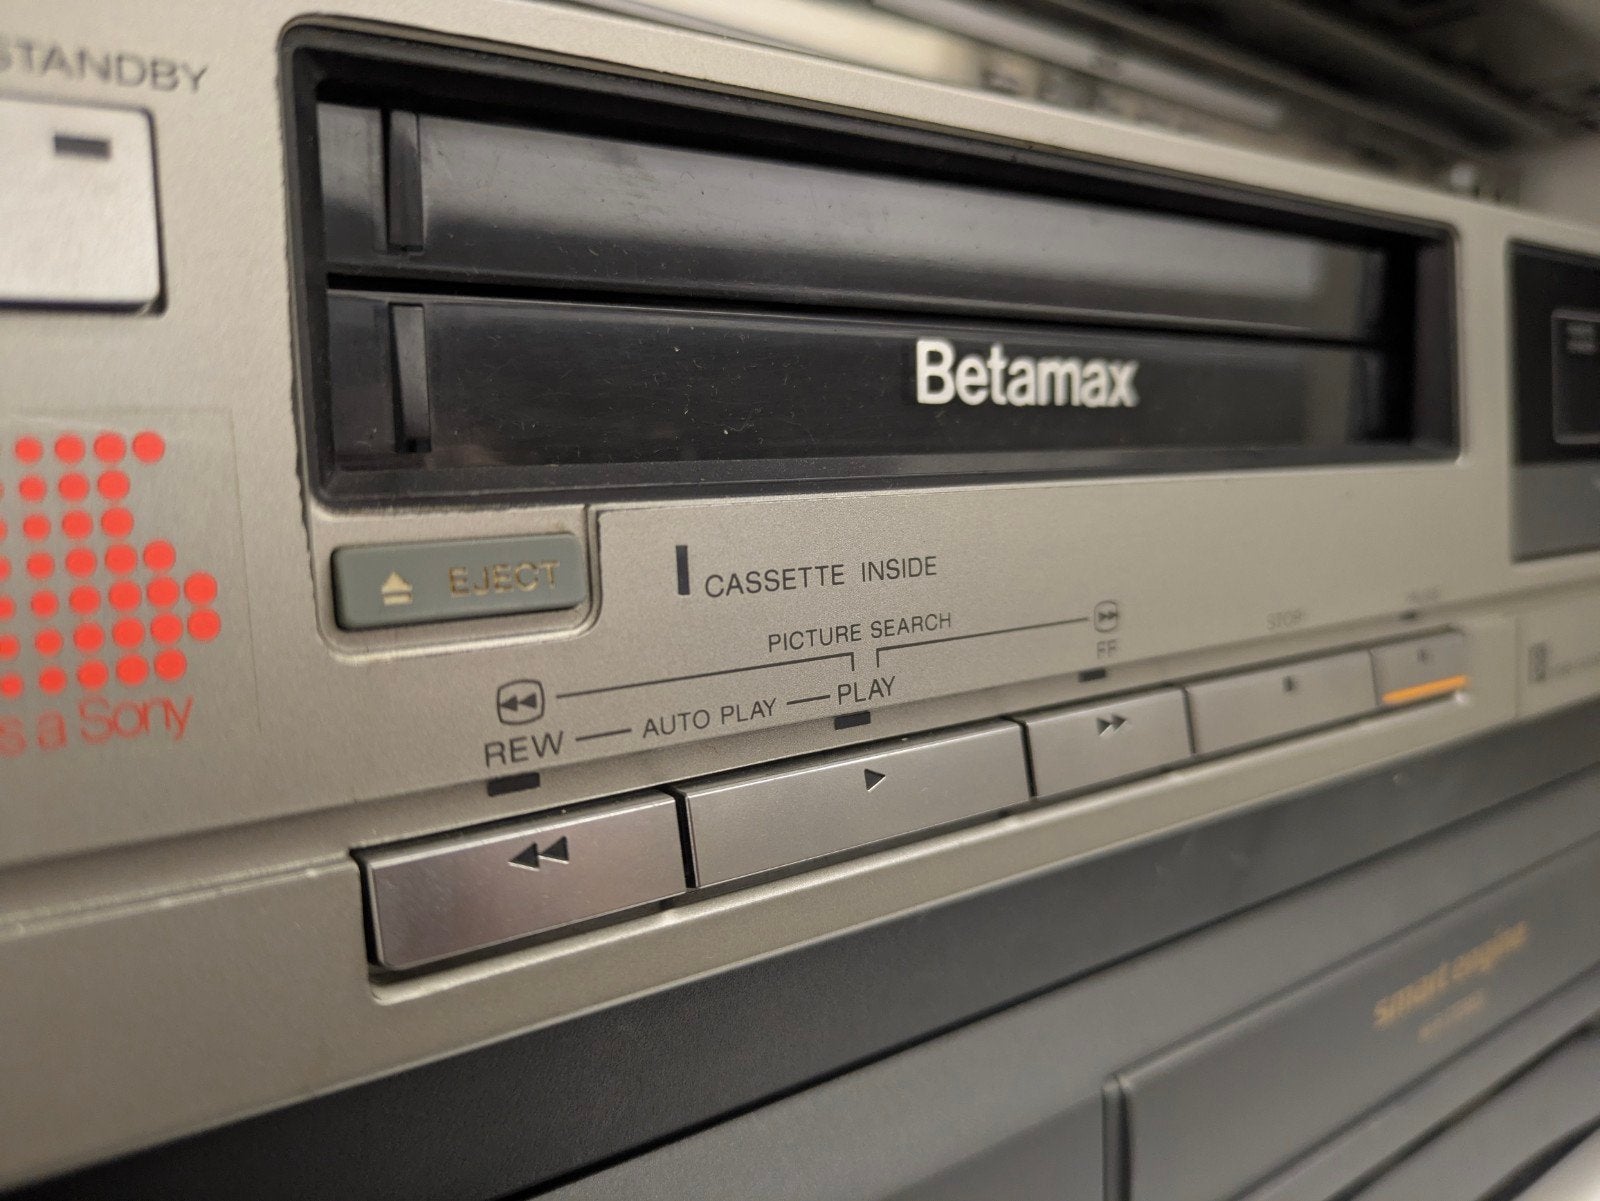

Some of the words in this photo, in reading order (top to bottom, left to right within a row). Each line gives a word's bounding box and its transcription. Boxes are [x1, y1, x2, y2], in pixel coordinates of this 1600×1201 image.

[916, 337, 1141, 409] Betamax
[448, 560, 560, 598] EJECT
[704, 563, 846, 599] CASSETTE
[860, 555, 938, 583] INSIDE
[768, 623, 863, 653] PICTURE
[870, 612, 952, 639] SEARCH
[1096, 639, 1118, 659] FF
[37, 711, 67, 751] a
[78, 695, 193, 743] Sony
[484, 731, 564, 768] REW
[642, 708, 712, 739] AUTO
[720, 697, 777, 726] PLAY
[837, 676, 897, 706] PLAY
